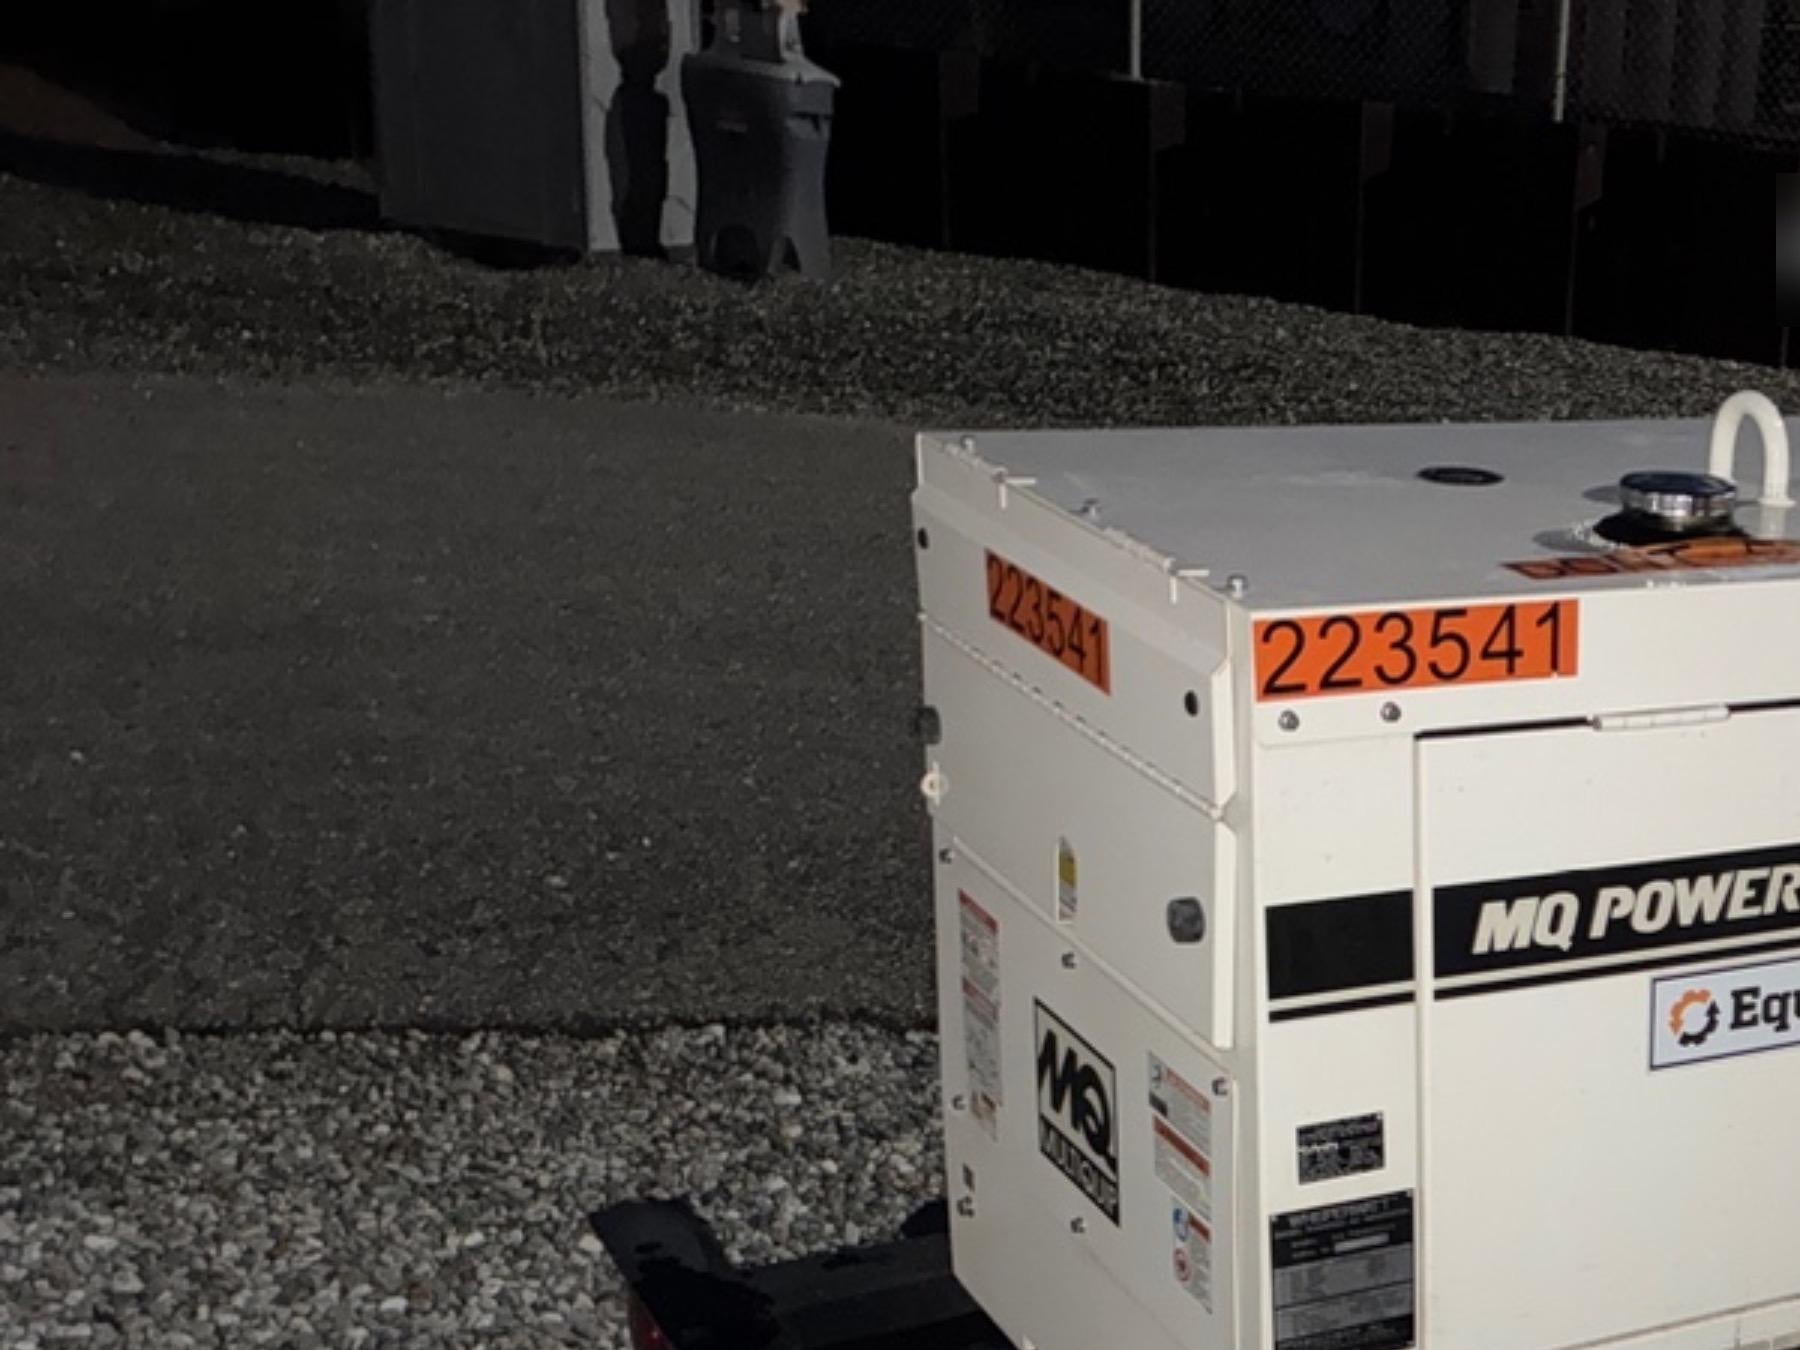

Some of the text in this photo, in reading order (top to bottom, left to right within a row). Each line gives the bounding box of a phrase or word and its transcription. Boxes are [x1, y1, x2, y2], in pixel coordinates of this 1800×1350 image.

[985, 552, 1104, 687] 223541
[1261, 601, 1561, 695] 223541
[1471, 890, 1581, 956] MQ
[1038, 1027, 1117, 1176] MQ
